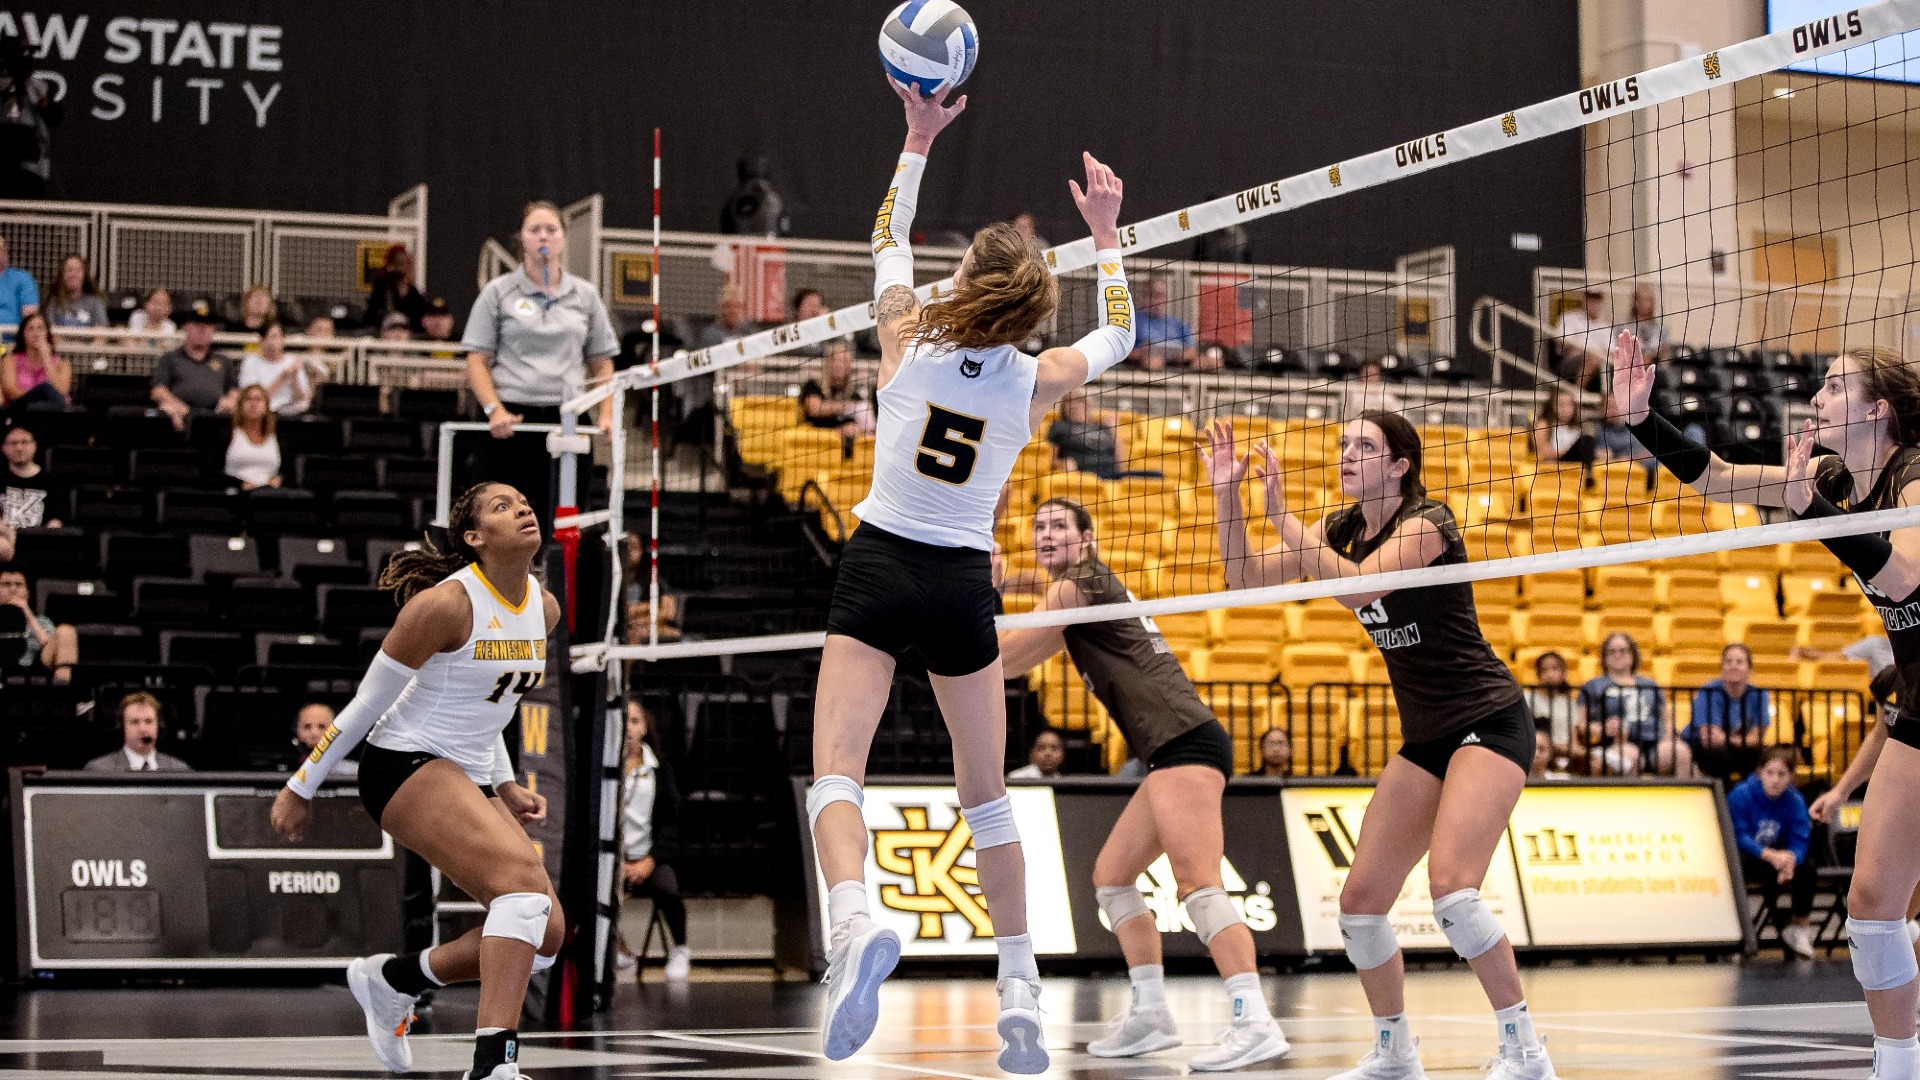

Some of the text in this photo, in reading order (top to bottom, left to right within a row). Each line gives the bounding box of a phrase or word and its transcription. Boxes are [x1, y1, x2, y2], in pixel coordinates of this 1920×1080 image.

[104, 16, 283, 71] STATE
[1792, 9, 1863, 54] OWLS
[1578, 76, 1640, 115] OWLS
[1395, 133, 1447, 168] OWLS
[1236, 182, 1282, 214] OWLS
[913, 400, 989, 488] 5
[472, 639, 534, 661] KENNESAW
[483, 670, 544, 706] 14
[1586, 832, 1685, 847] AMERICAN
[71, 859, 148, 888] OWLS
[1588, 851, 1688, 864] CAMPUS
[268, 870, 340, 894] PERIOD
[1530, 876, 1579, 895] Where
[1582, 876, 1645, 895] students
[1646, 876, 1676, 895] love
